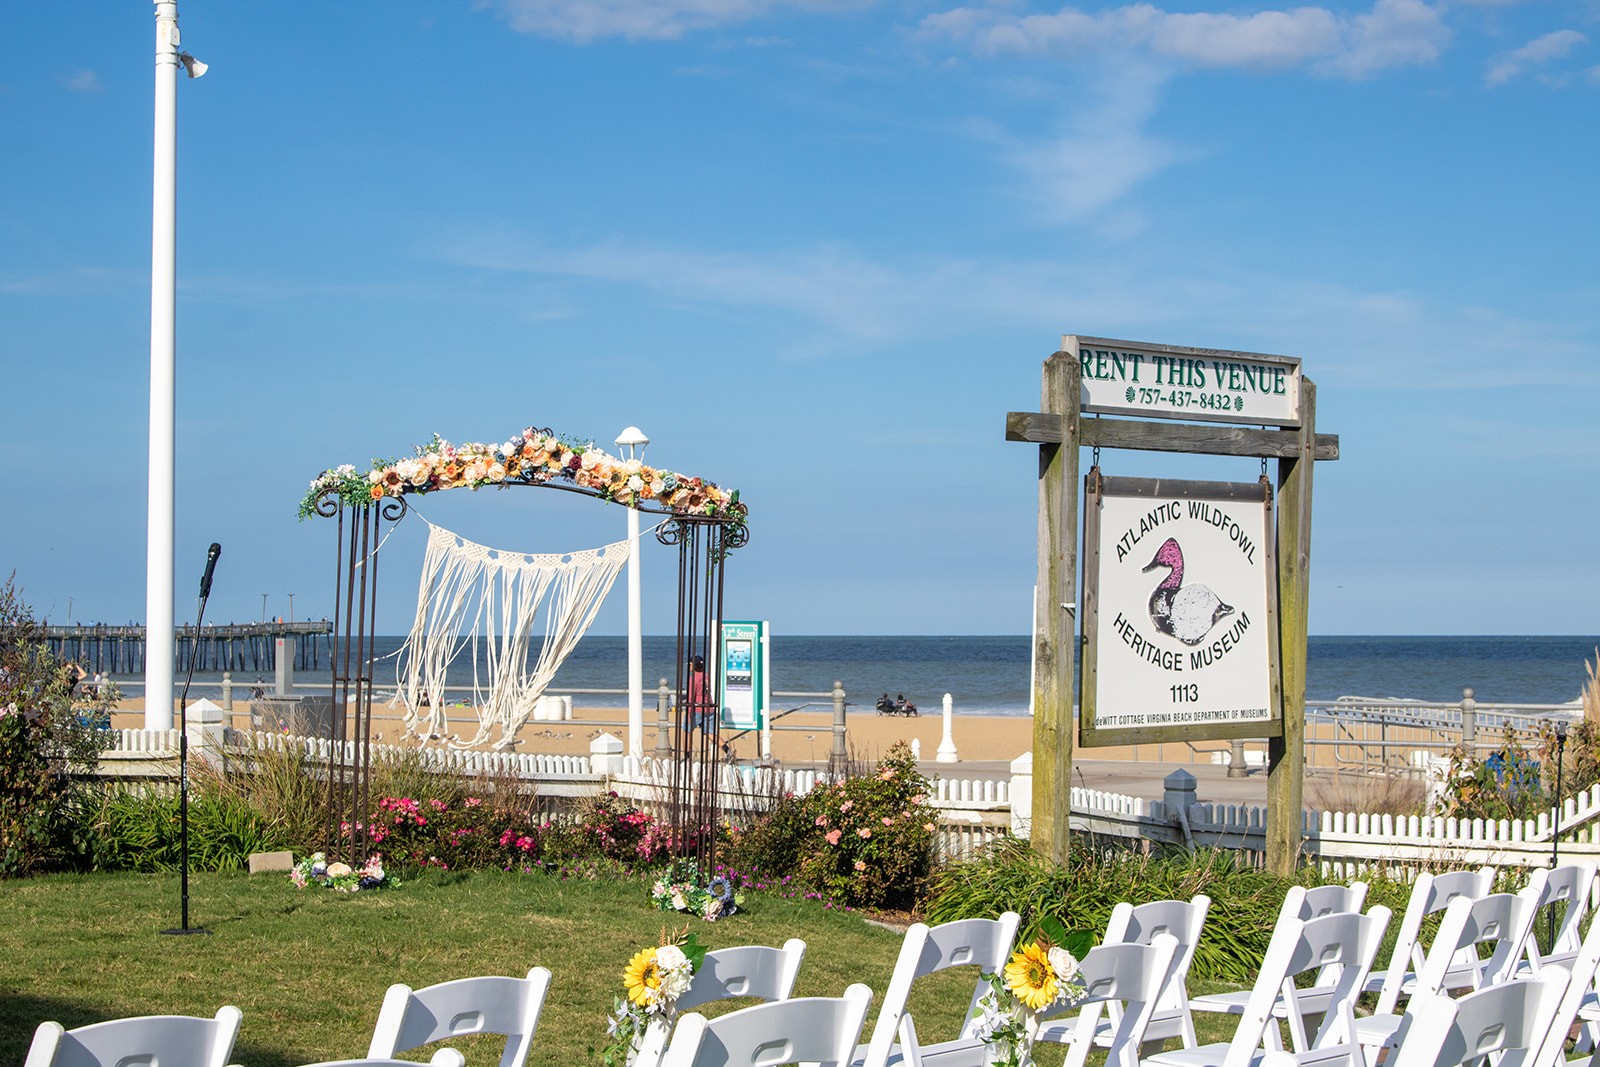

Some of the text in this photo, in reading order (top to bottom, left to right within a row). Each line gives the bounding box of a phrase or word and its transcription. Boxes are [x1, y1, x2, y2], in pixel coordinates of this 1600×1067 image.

[1079, 349, 1286, 395] RENT THIS VENUE
[1138, 387, 1231, 411] 757-437-8432
[1115, 500, 1256, 565] ATLANTIC WILDFOWL
[1113, 611, 1251, 672] HERITAGE MUSEUM
[1169, 683, 1199, 703] 1113
[1119, 714, 1145, 725] COTTAGE
[1147, 713, 1172, 723] VIRGINIA
[1173, 712, 1193, 722] BEACH
[1193, 710, 1230, 721] DEPARTMENT
[1231, 709, 1239, 719] OF
[1240, 708, 1268, 719] MUSEUMS
